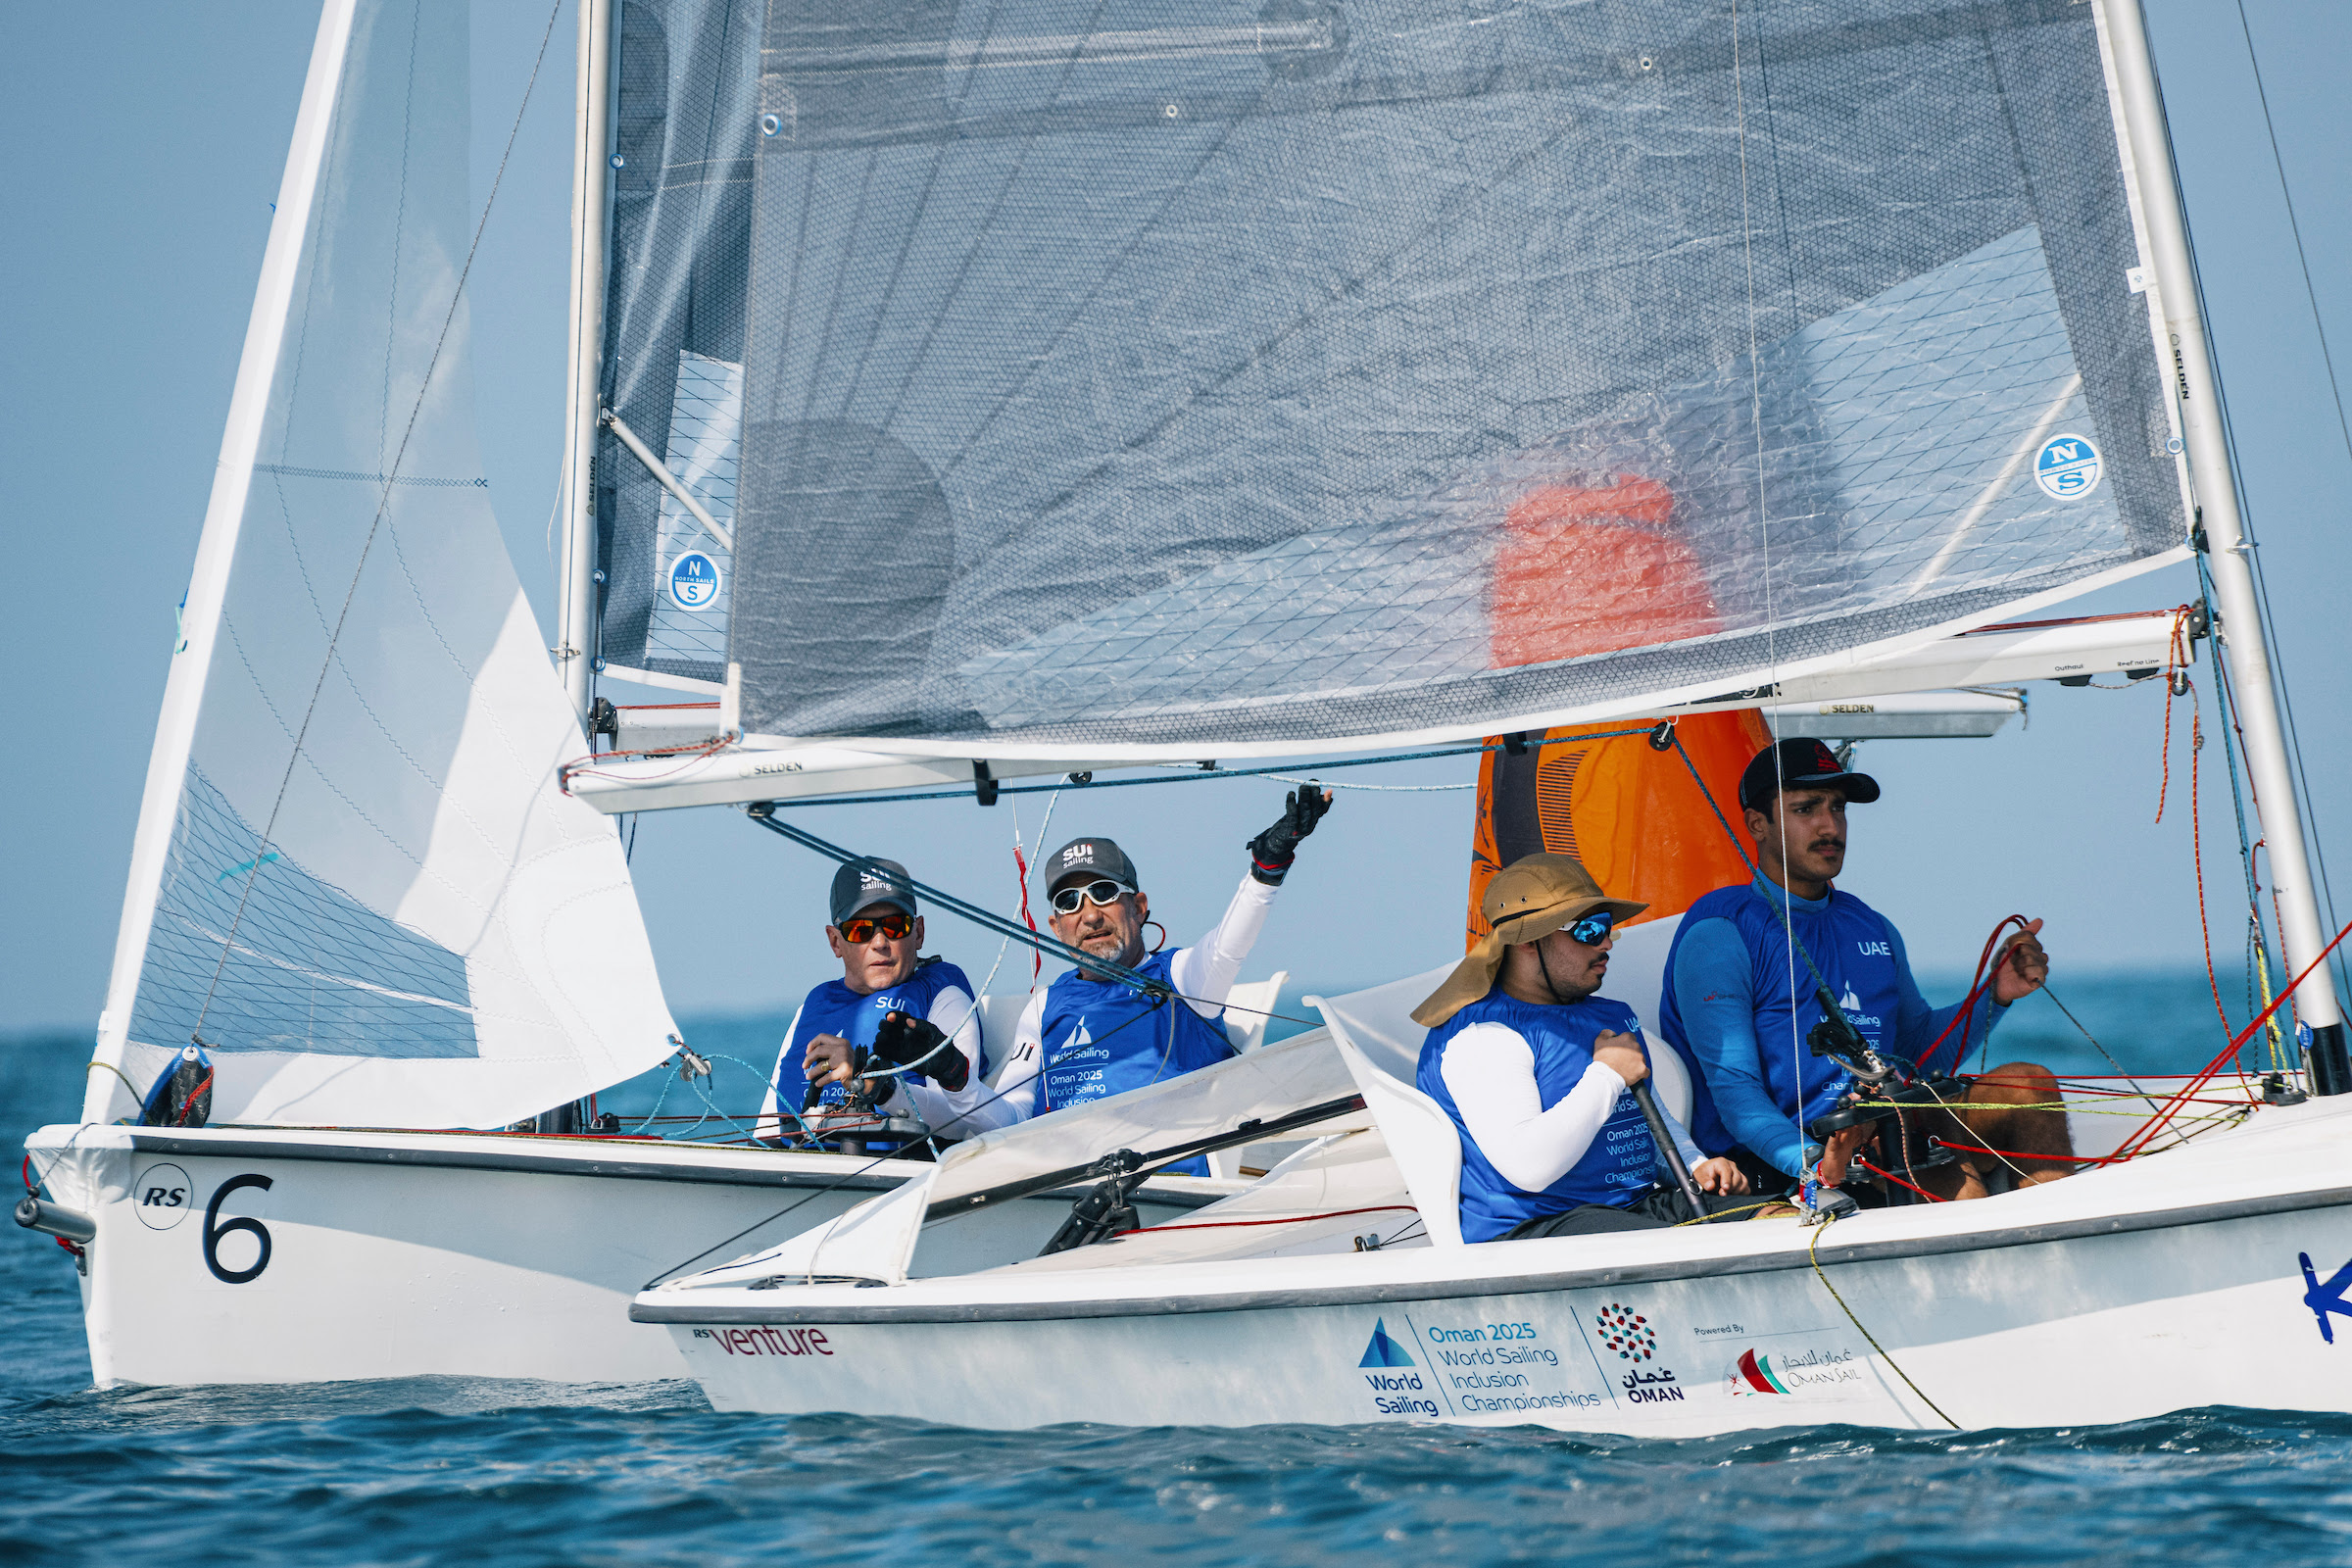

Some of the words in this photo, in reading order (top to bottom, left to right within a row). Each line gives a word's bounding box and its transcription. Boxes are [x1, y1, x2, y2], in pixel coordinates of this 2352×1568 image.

[2048, 442, 2079, 464] N
[2058, 470, 2084, 490] S
[688, 561, 701, 576] N
[687, 585, 698, 601] S
[1063, 857, 1094, 869] sailing
[860, 881, 892, 891] sailing
[1857, 941, 1891, 956] UAE
[875, 996, 906, 1011] SUI
[1624, 1016, 1641, 1033] UA
[1073, 1047, 1109, 1059] Sailing
[1051, 1074, 1075, 1085] Oman
[1077, 1069, 1102, 1081] 2025
[1048, 1085, 1074, 1098] World
[1074, 1083, 1106, 1095] Sailing
[1606, 1128, 1634, 1142] Oman
[1606, 1140, 1634, 1155] World
[142, 1187, 186, 1207] RS
[202, 1173, 274, 1285] 6
[1428, 1326, 1488, 1344] Oman
[1487, 1322, 1537, 1341] 2025
[1693, 1324, 1732, 1336] Powered
[1732, 1323, 1744, 1334] By
[692, 1328, 710, 1339] RS
[708, 1325, 834, 1355] venture
[1437, 1348, 1495, 1366] World
[1495, 1346, 1559, 1366] Sailing
[1365, 1372, 1423, 1391] World
[1448, 1370, 1530, 1390] Inclusion
[1461, 1391, 1601, 1414] Championships
[1628, 1387, 1685, 1403] OMAN
[1375, 1396, 1439, 1417] Sailing
